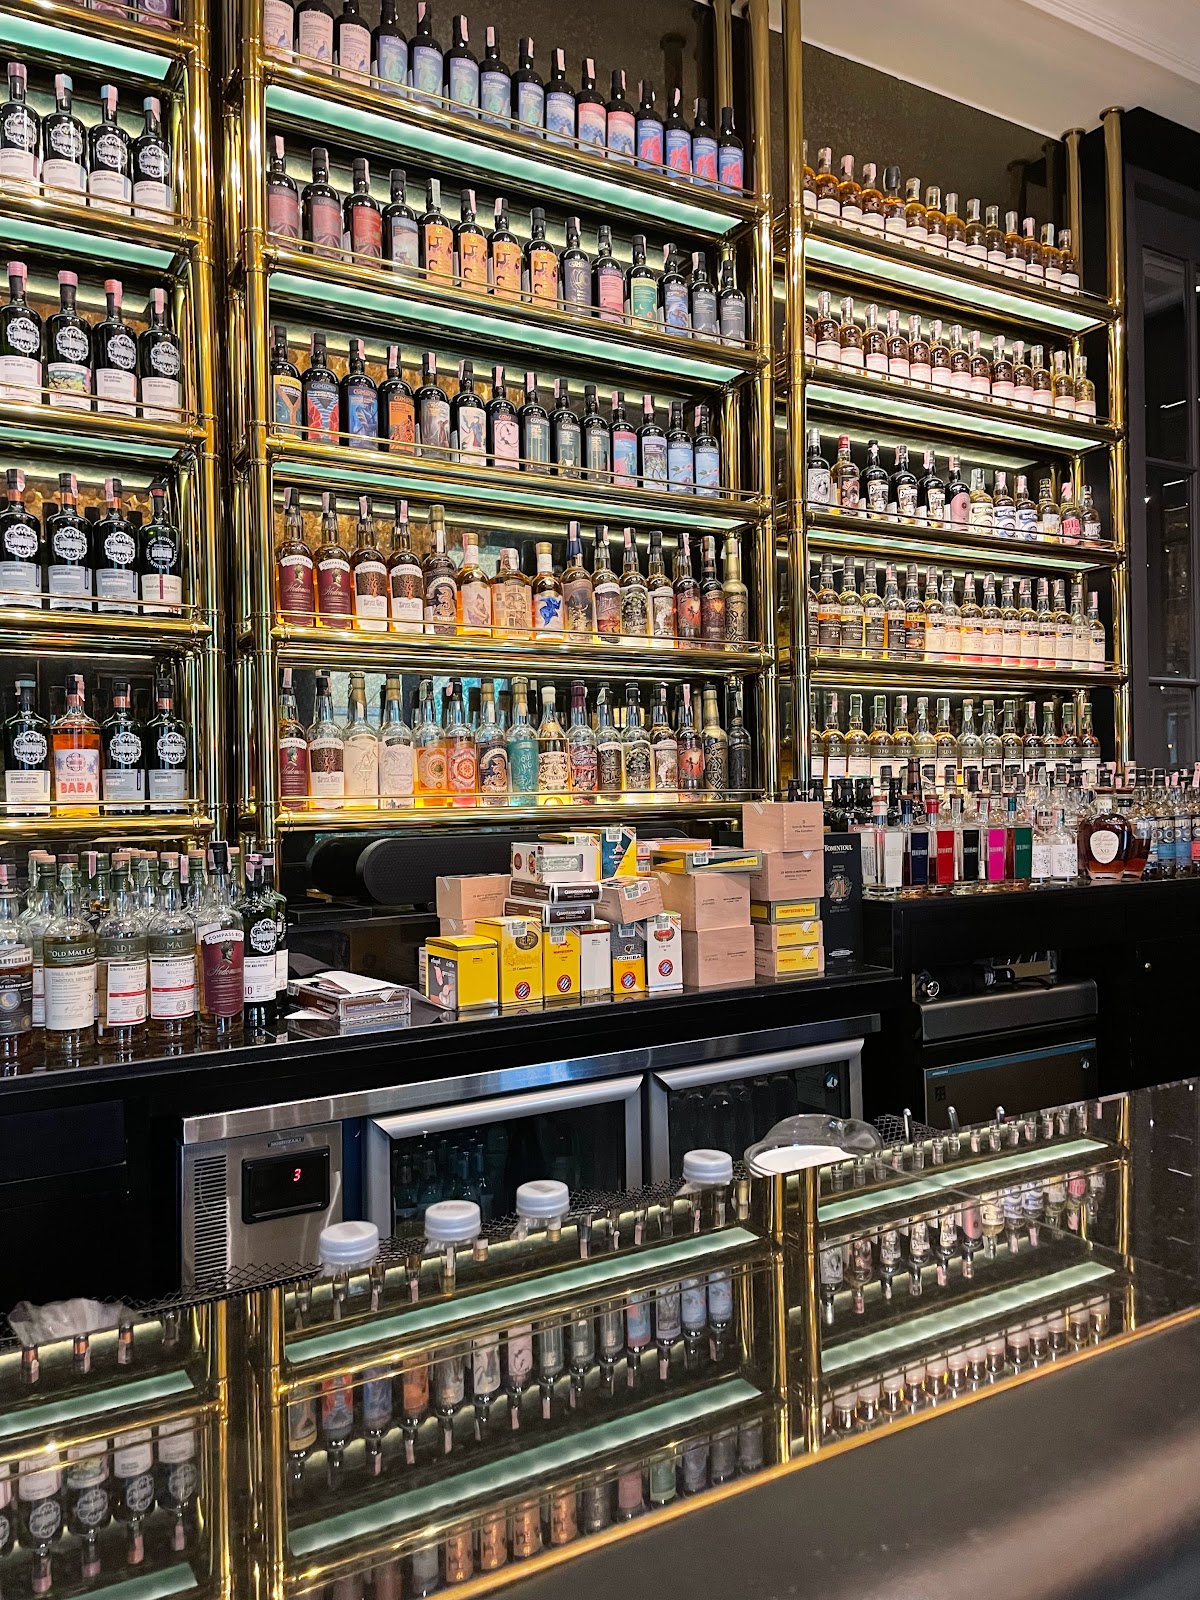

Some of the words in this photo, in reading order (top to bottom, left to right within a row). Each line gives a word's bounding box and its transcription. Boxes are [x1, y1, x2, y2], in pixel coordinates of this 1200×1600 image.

[158, 536, 175, 547] SCOTCH
[60, 782, 93, 794] BABA
[830, 879, 847, 898] 21
[209, 932, 234, 940] COMPASS
[110, 944, 126, 952] OLD
[177, 978, 186, 986] 29
[293, 1168, 301, 1181] 3
